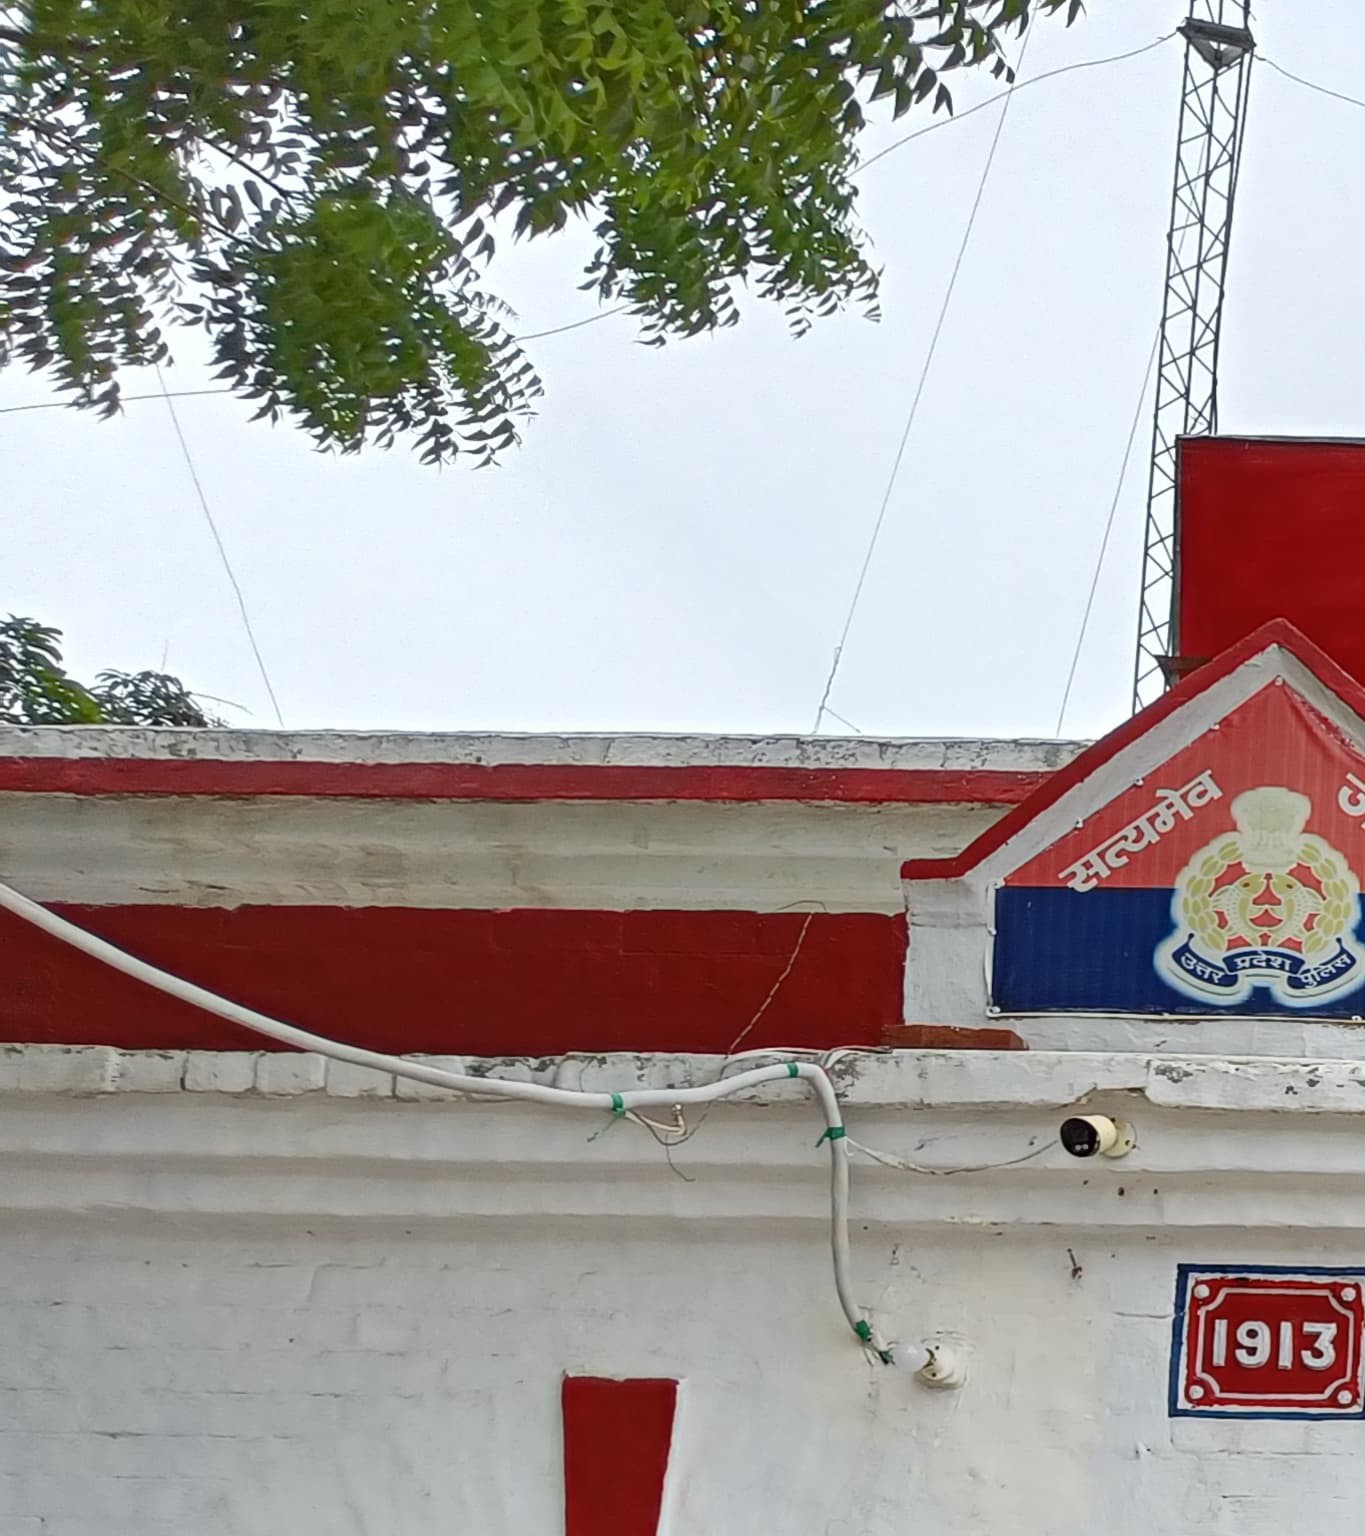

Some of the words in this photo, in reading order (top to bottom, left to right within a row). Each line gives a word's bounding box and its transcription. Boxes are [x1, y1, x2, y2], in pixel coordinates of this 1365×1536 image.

[1057, 769, 1224, 894] सत्यमेव
[1179, 951, 1225, 985] उत्तर
[1232, 949, 1292, 972] प्रदेश
[1300, 952, 1352, 989] पुलिस
[1211, 1317, 1338, 1372] 1913
